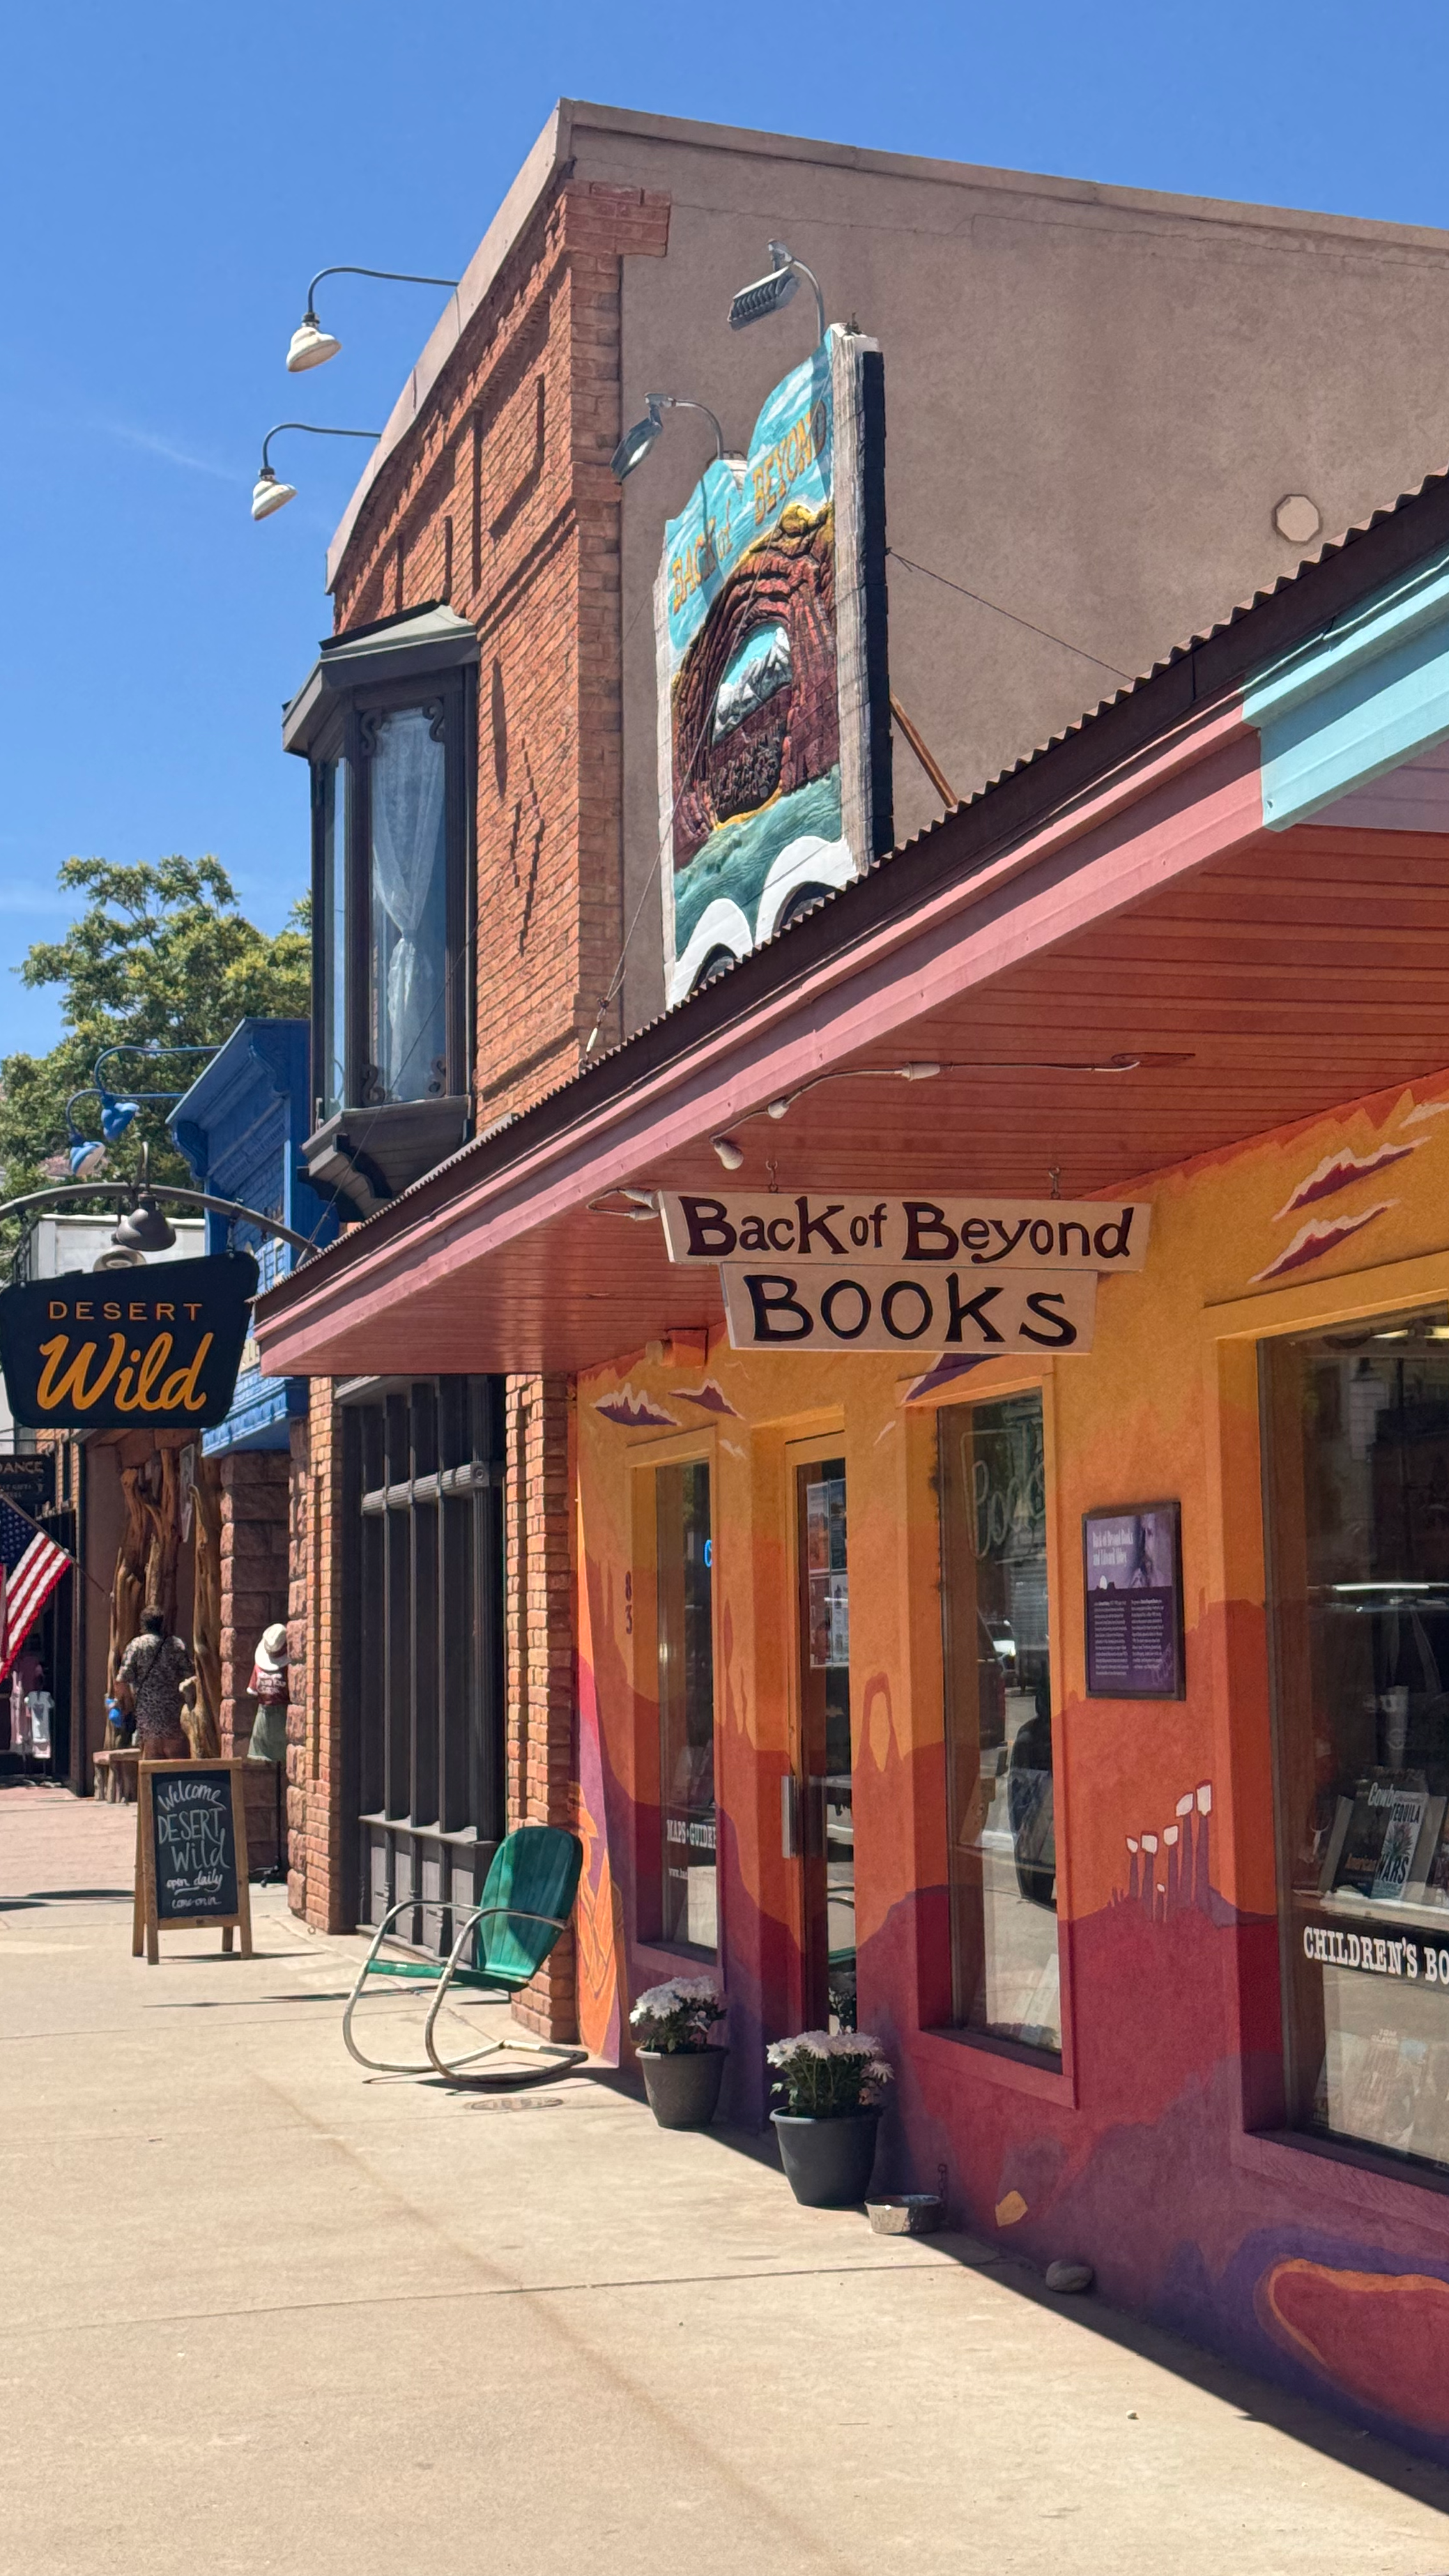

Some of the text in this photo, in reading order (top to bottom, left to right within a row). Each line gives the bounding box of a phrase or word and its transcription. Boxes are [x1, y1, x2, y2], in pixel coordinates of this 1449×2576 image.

[753, 401, 827, 526] BEYOND
[671, 517, 716, 615] BACK
[850, 1202, 887, 1248] of
[901, 1201, 1135, 1264] Beyond
[49, 1301, 203, 1321] DESERT
[743, 1273, 1078, 1347] BOOKS
[36, 1332, 214, 1411] Wild
[157, 1780, 227, 1811] Welcome
[1390, 1803, 1421, 1823] TEQUILA
[157, 1807, 224, 1845] DESERT
[666, 1819, 686, 1844] MAPS
[171, 1828, 231, 1873] Wild
[1375, 1854, 1409, 1884] WARS
[166, 1870, 223, 1892] open daily
[1303, 1926, 1418, 1978] CHILDREN'S
